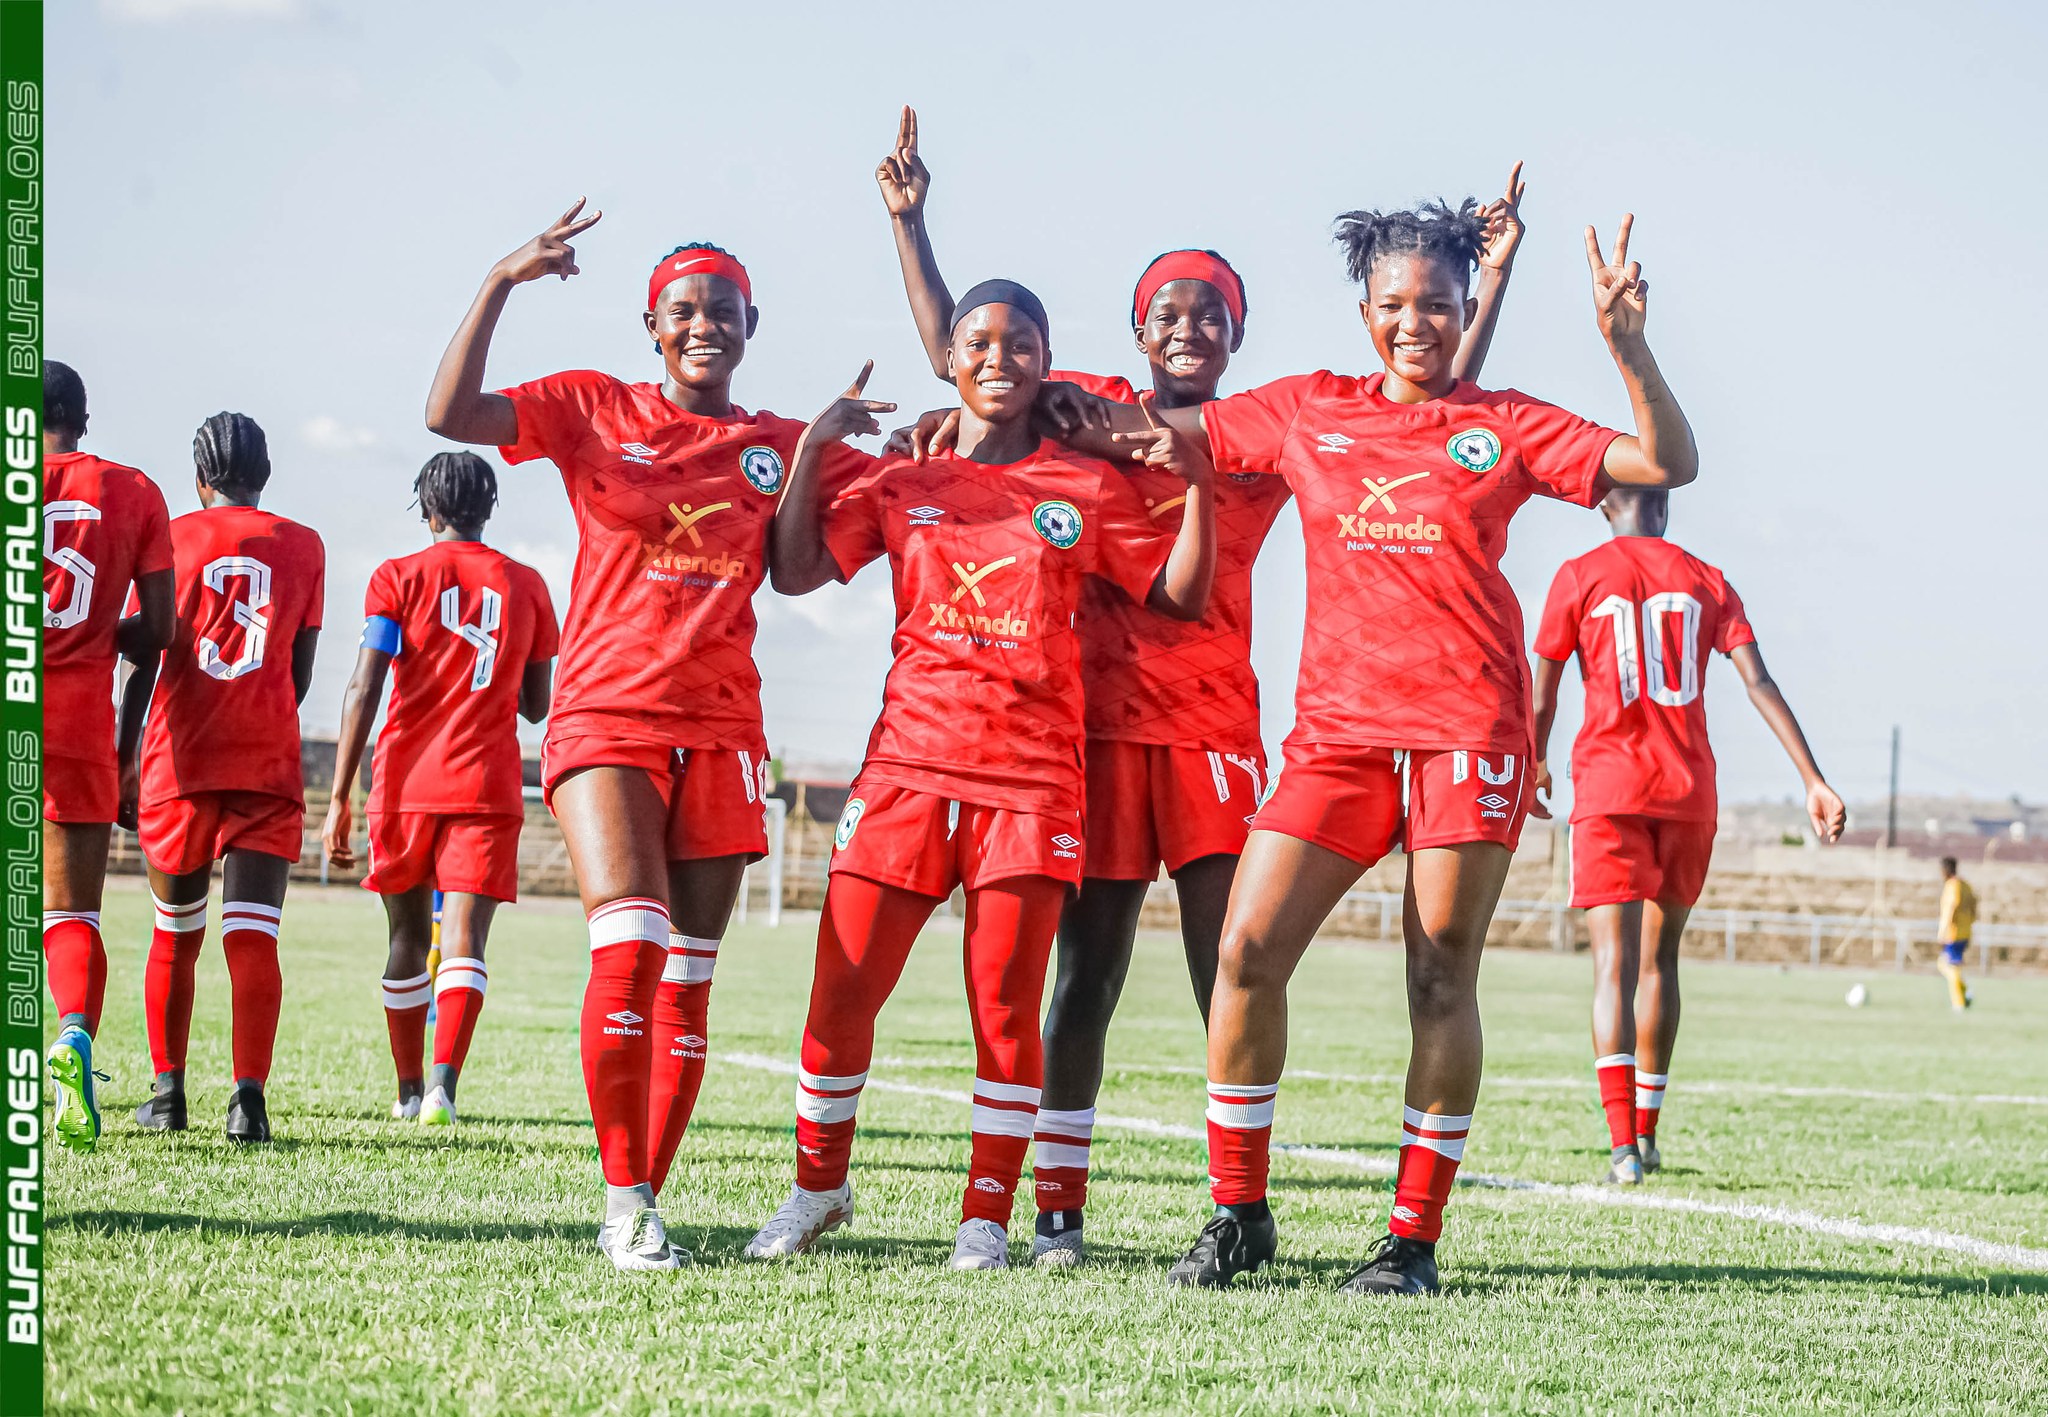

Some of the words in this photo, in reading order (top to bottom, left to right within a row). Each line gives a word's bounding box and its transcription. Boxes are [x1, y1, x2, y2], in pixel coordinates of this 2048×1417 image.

[1317, 444, 1348, 454] umbro
[621, 455, 653, 466] umbro
[908, 518, 940, 526] umbro
[1336, 514, 1442, 542] Xtenda
[1346, 540, 1377, 551] Now
[1380, 545, 1406, 554] you
[1411, 545, 1433, 554] can
[43, 500, 102, 630] 5
[640, 543, 746, 578] Xtenda
[646, 570, 680, 582] Now
[683, 576, 708, 587] you
[199, 556, 272, 680] 3
[928, 603, 1029, 637] Xtenda
[441, 585, 502, 693] 4
[934, 630, 964, 642] Now
[967, 634, 991, 646] you
[995, 639, 1018, 649] can
[1590, 591, 1702, 708] 10
[1481, 809, 1507, 819] umbro
[1053, 849, 1077, 859] umbro
[603, 1026, 643, 1036] umbro
[670, 1048, 705, 1059] umbro
